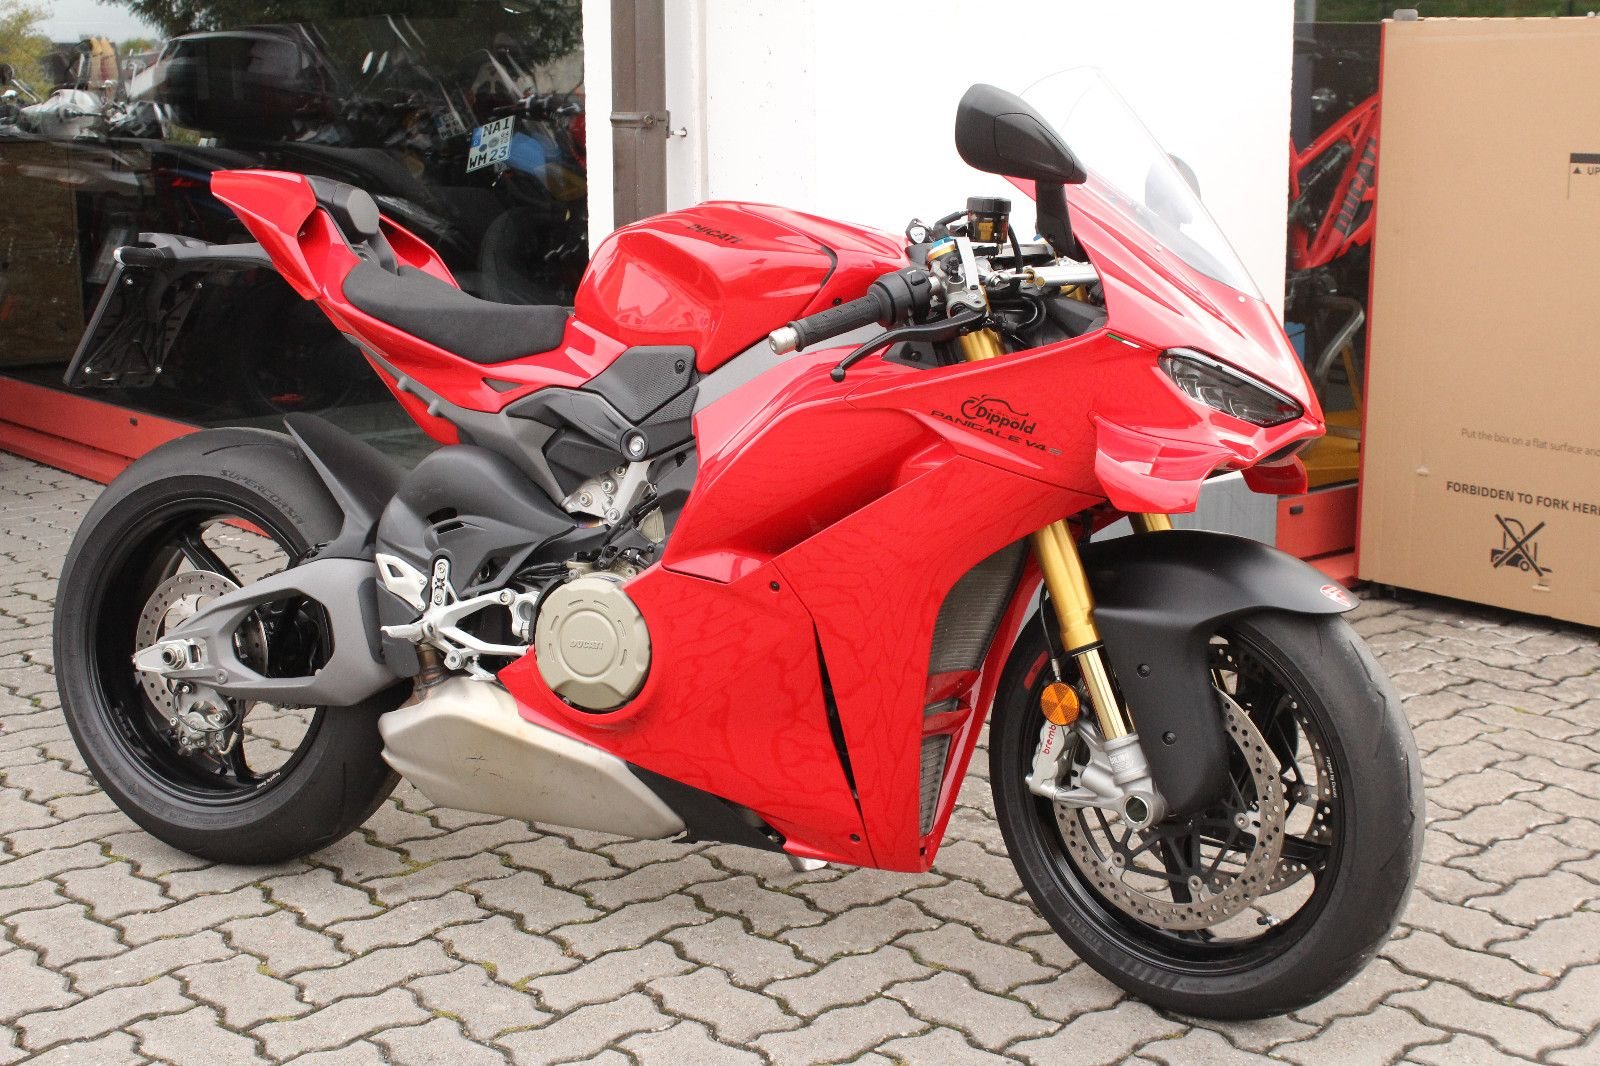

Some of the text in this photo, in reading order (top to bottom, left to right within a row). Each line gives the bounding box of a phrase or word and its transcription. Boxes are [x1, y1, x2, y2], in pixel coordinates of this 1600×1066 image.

[482, 117, 509, 137] NAI
[469, 146, 508, 169] WM 23
[687, 224, 743, 244] DUCATI
[930, 410, 1022, 443] PANIGALE
[1025, 439, 1046, 451] V4
[975, 405, 1037, 434] Dippold
[1461, 428, 1476, 439] Put
[1478, 431, 1492, 442] the
[1494, 433, 1510, 443] box
[1511, 437, 1524, 445] on
[1533, 438, 1548, 449] flat
[1550, 442, 1583, 454] surface
[1446, 480, 1600, 516] FORBIDDEN TO FORK HER
[1043, 723, 1057, 755] bremb
